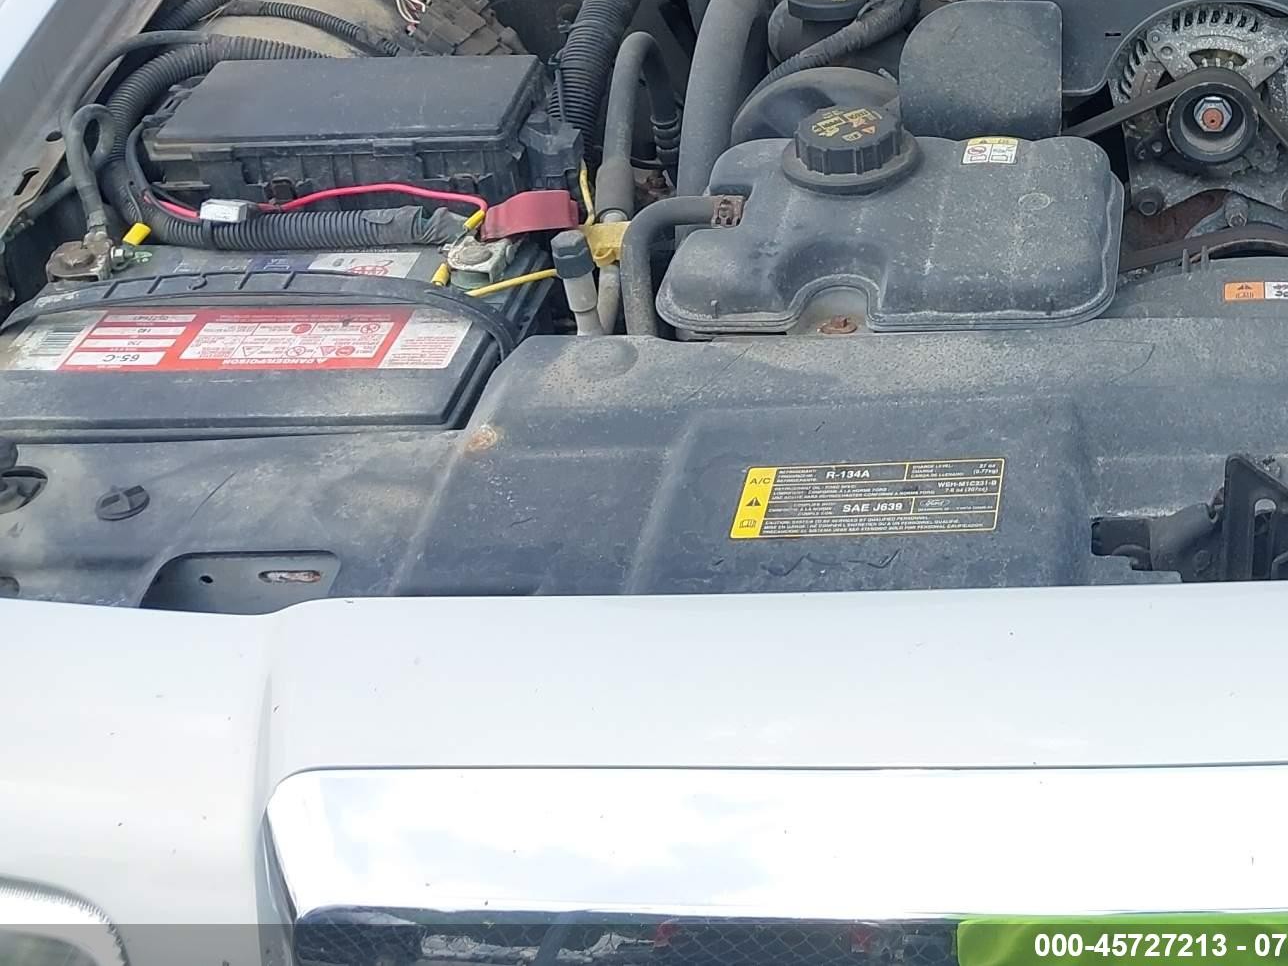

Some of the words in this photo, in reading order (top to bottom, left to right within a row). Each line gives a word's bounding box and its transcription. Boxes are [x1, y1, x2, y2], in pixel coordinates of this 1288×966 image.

[103, 354, 140, 363] 65-C
[826, 469, 870, 480] R-134A
[750, 477, 771, 485] A/C
[842, 503, 870, 513] SAE
[873, 502, 903, 512] J639
